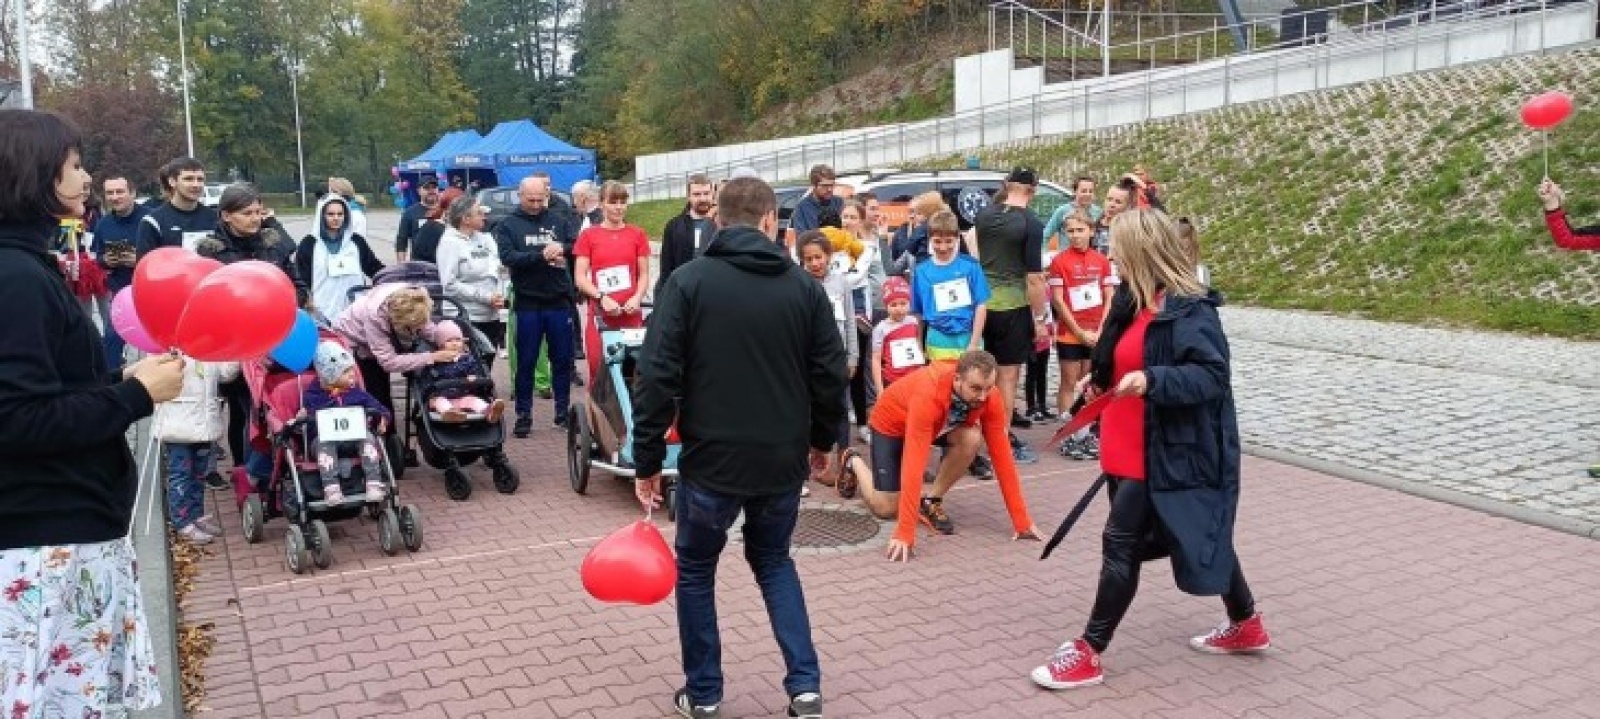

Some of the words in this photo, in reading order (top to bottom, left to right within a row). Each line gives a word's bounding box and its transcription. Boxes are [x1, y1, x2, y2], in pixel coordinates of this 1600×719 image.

[948, 289, 959, 303] 5
[906, 347, 915, 360] 5
[332, 418, 350, 432] 10
